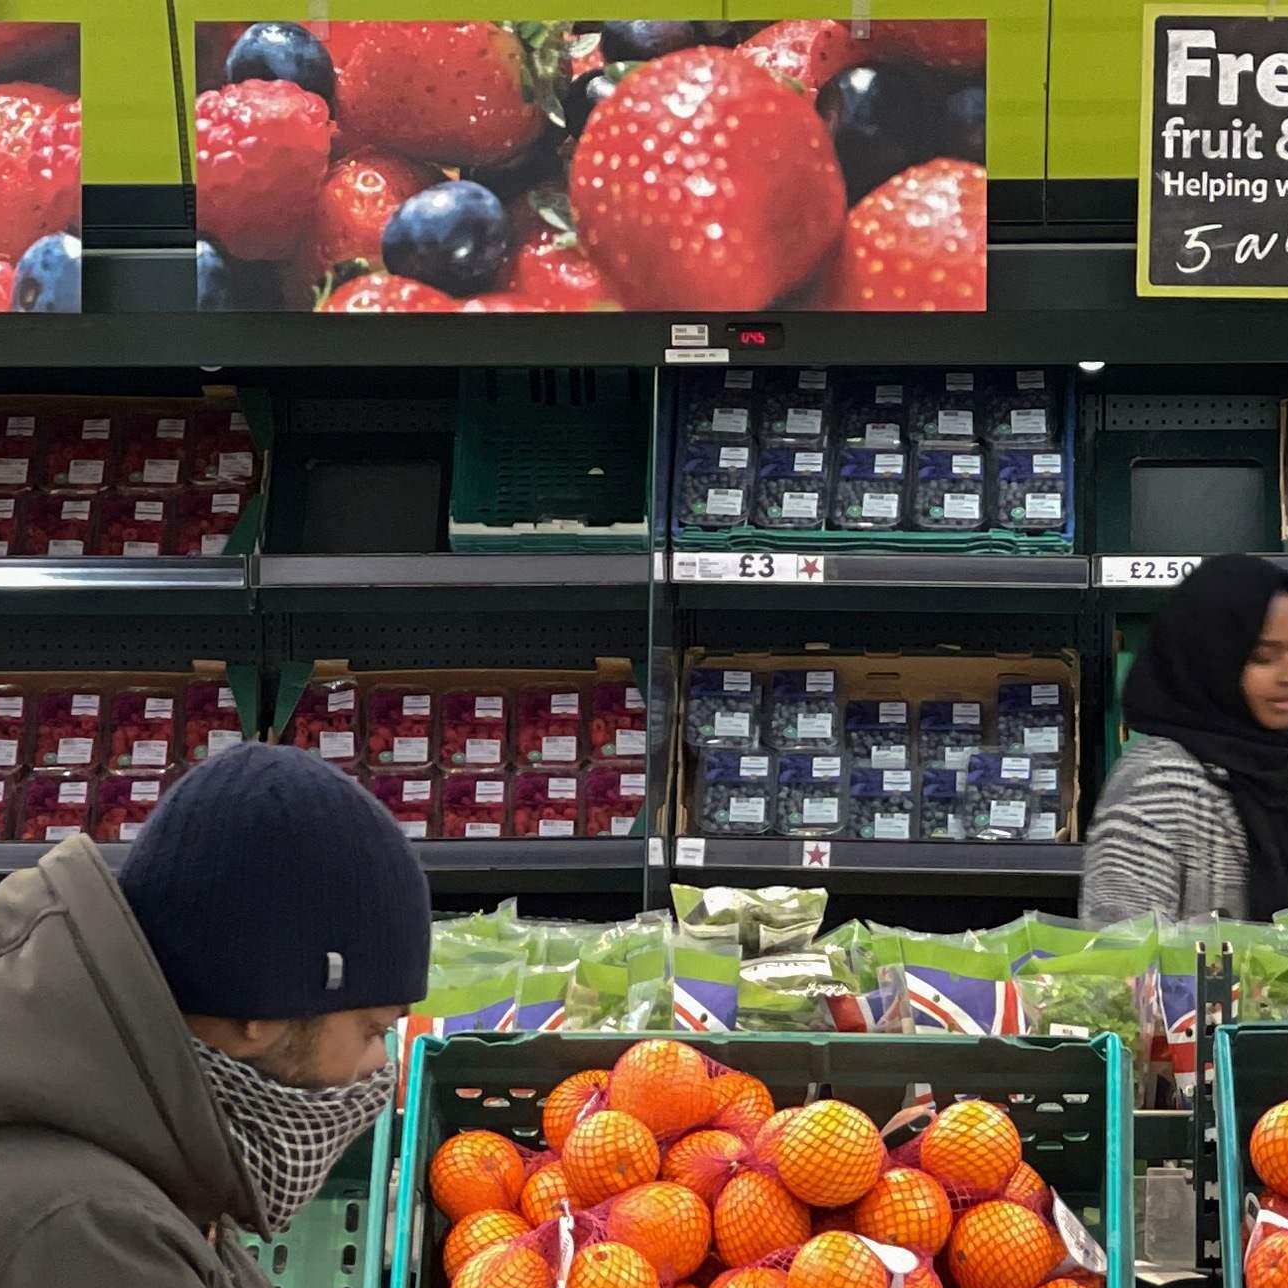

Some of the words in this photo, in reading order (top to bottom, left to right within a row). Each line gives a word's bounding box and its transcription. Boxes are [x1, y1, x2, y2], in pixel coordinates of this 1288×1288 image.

[1162, 117, 1263, 160] fruit
[1162, 172, 1267, 203] Helping
[1176, 224, 1223, 274] 5
[1234, 234, 1278, 265] a
[738, 554, 775, 578] £3
[1130, 561, 1195, 579] £2.50
